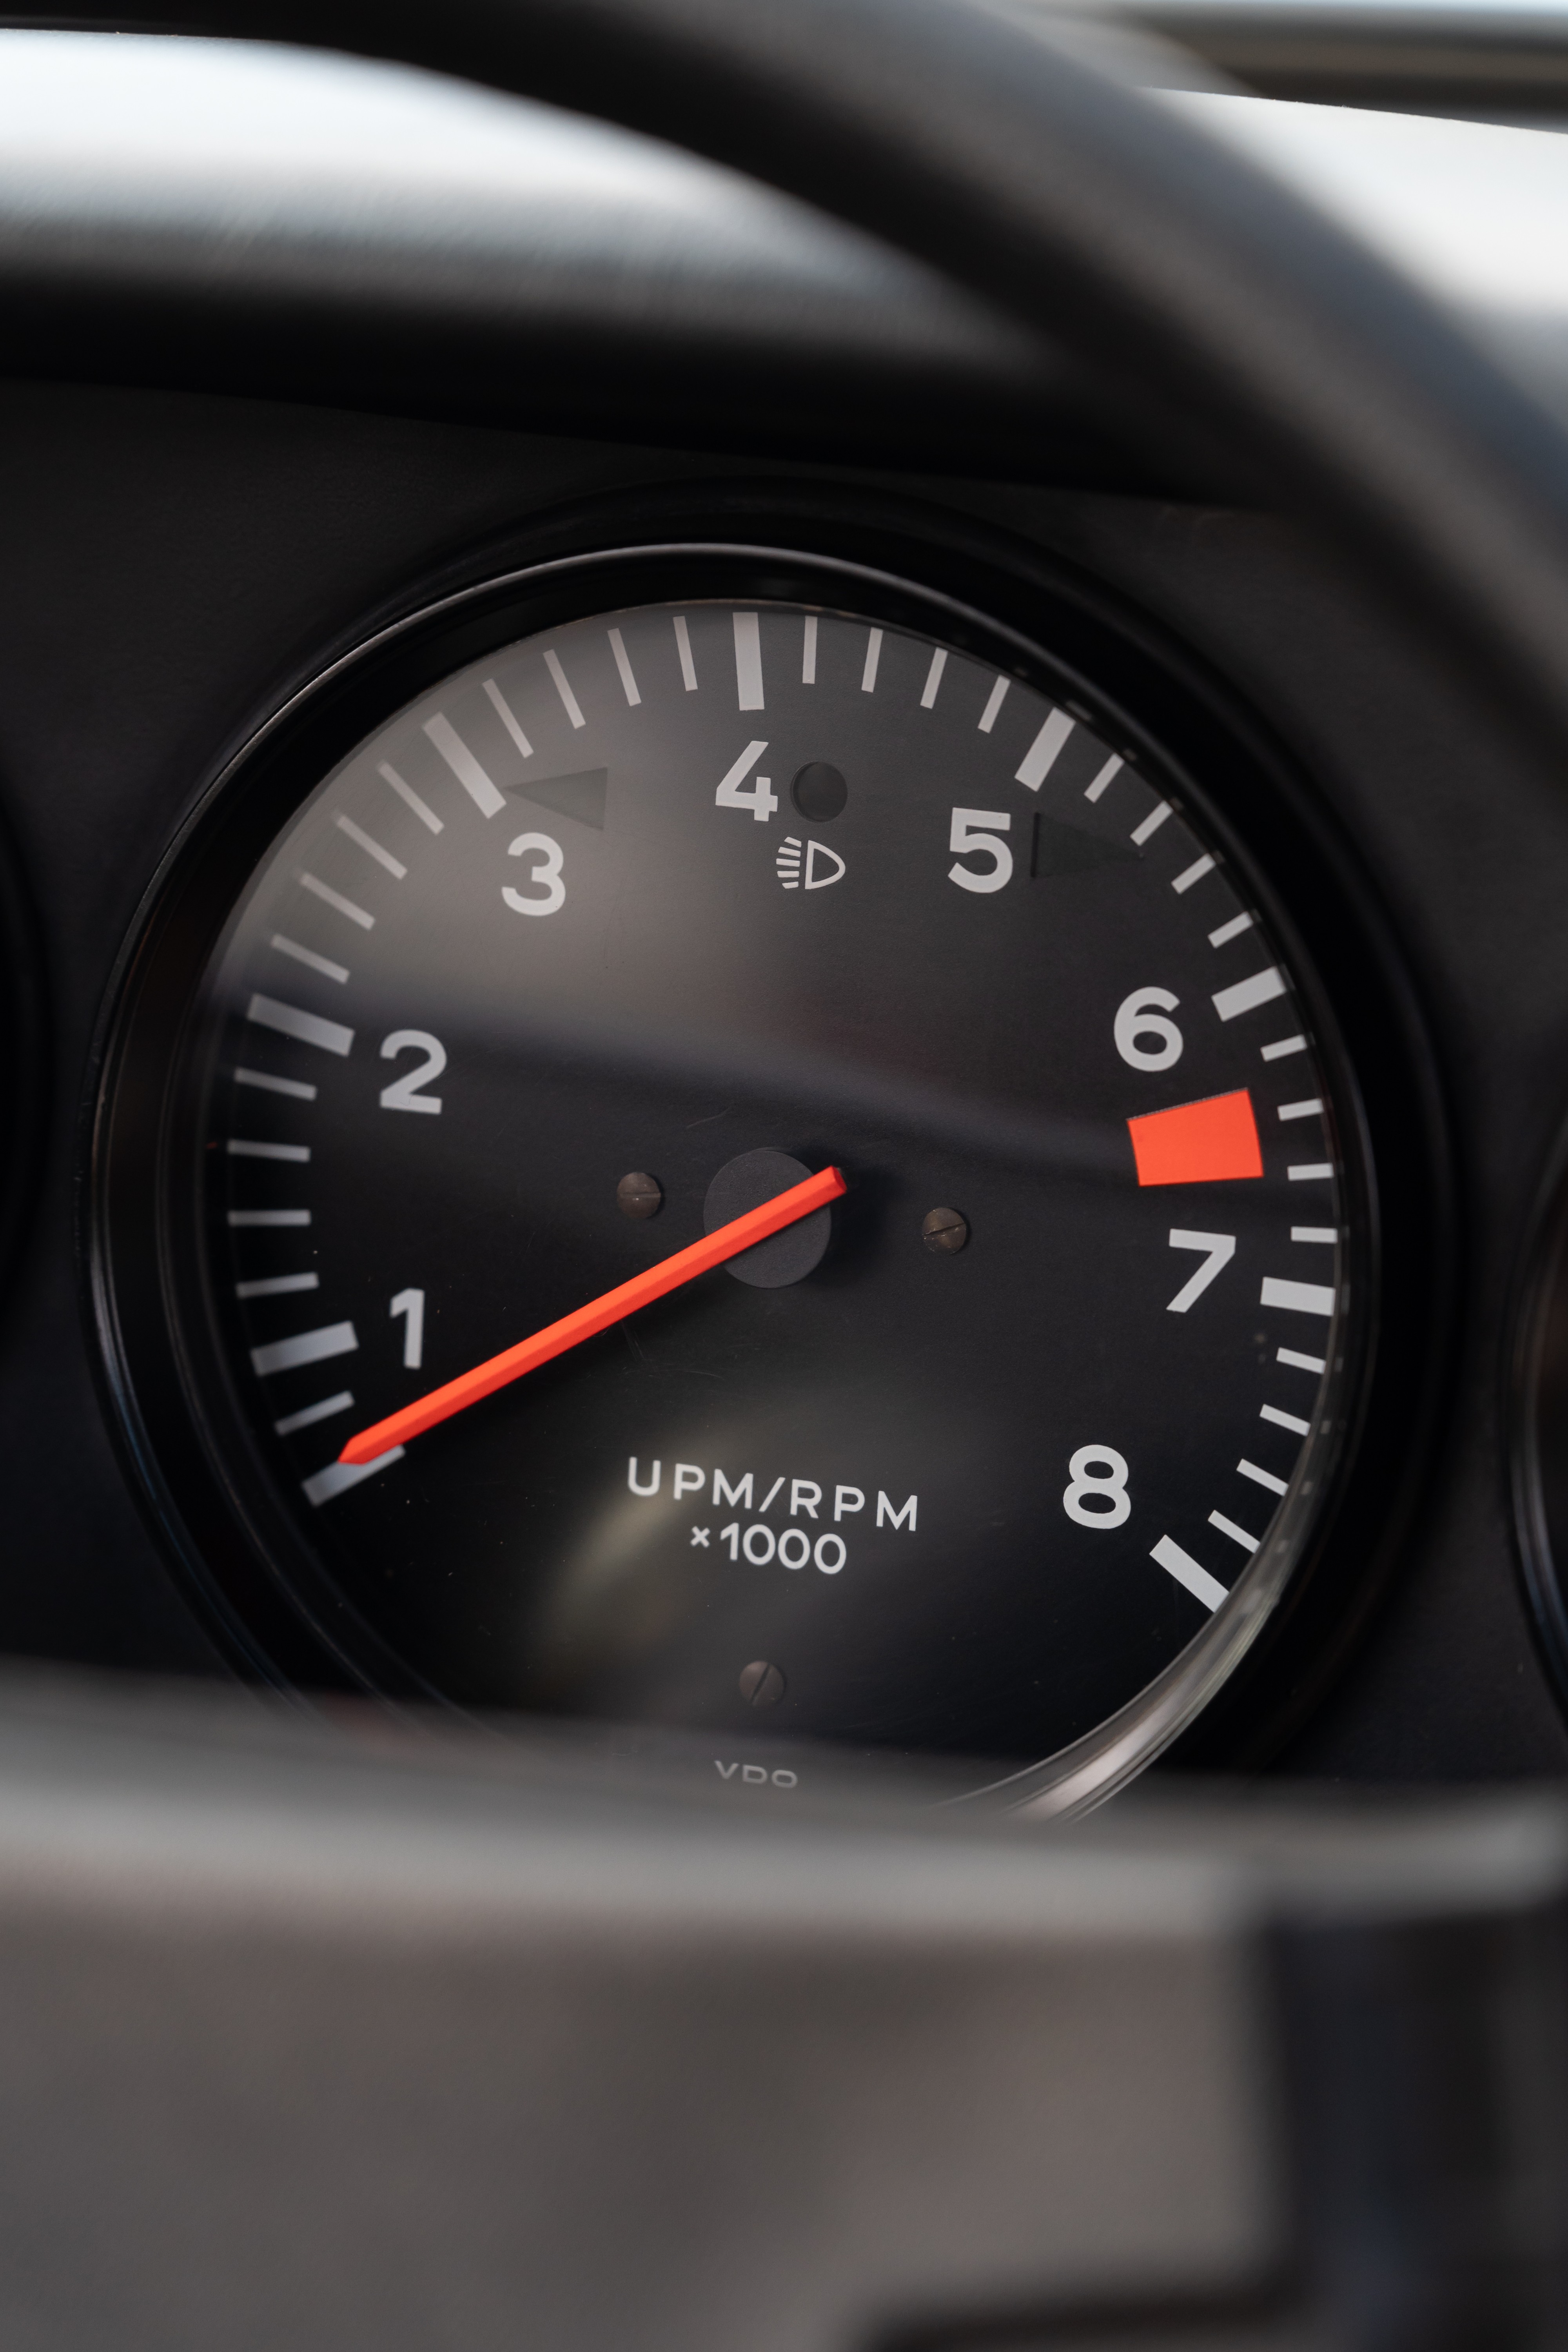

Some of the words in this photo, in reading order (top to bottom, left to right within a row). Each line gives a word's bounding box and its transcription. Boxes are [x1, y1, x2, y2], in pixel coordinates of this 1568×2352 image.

[715, 740, 778, 822] 4
[501, 832, 566, 916] 3
[948, 807, 1013, 893] 5
[379, 1029, 447, 1114] 2
[1114, 987, 1183, 1072] 6
[1166, 1229, 1236, 1313] 7
[390, 1289, 425, 1369] 1
[628, 1457, 918, 1532] UPM/RPM
[1063, 1445, 1131, 1529] 8
[714, 1760, 798, 1789] VDO
